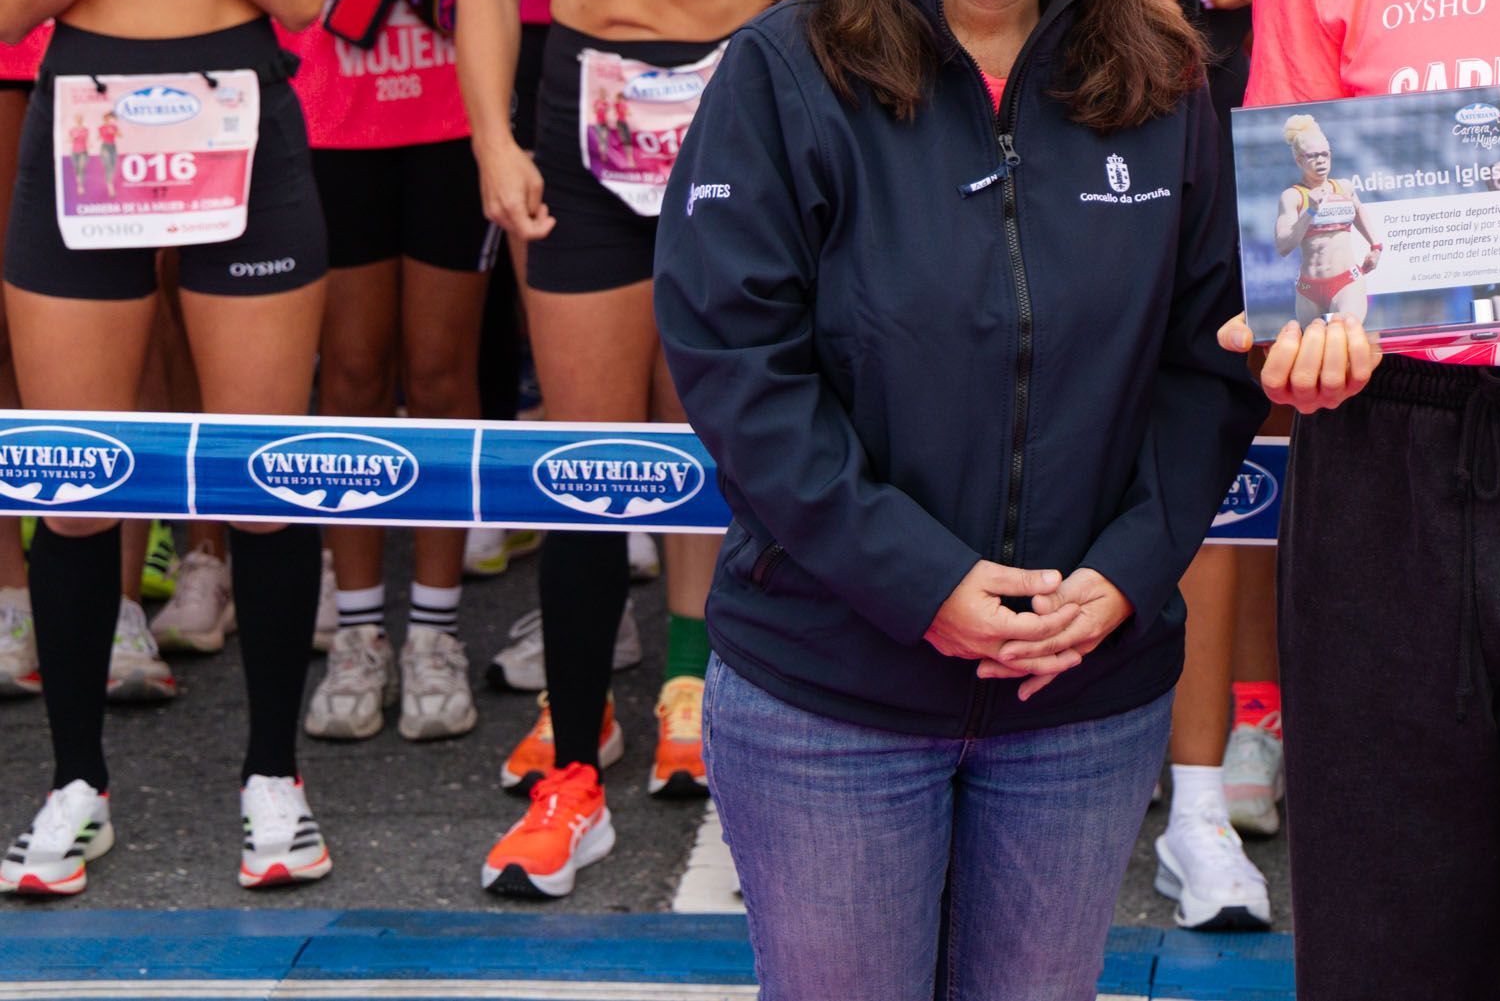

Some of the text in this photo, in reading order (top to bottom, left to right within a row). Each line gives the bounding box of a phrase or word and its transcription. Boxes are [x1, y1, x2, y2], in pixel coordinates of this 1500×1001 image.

[1452, 124, 1490, 136] Carrera
[636, 128, 691, 153] 01
[121, 153, 197, 184] 016
[1351, 169, 1450, 194] Adiaratou
[1080, 187, 1171, 204] Concello da Coruña
[1384, 214, 1399, 224] Por
[1412, 208, 1462, 222] trayectoria
[81, 221, 144, 238] OYSHO
[1387, 224, 1445, 239] compromiso
[1446, 220, 1472, 232] social
[1480, 220, 1496, 231] por
[1390, 240, 1431, 253] referente
[1433, 239, 1454, 249] para
[1455, 234, 1492, 246] mujeres
[1409, 255, 1420, 263] en
[1422, 253, 1431, 262] el
[1432, 250, 1464, 261] mundo
[1466, 248, 1480, 258] del
[229, 257, 296, 278] OYSHO
[42, 468, 97, 479] CENTRAL
[262, 452, 408, 486] ASTURIANA
[545, 459, 693, 492] ASTURIANA
[266, 475, 382, 486] CENTRAL LECHERA
[552, 482, 667, 494] CENTRAL LECHERA
